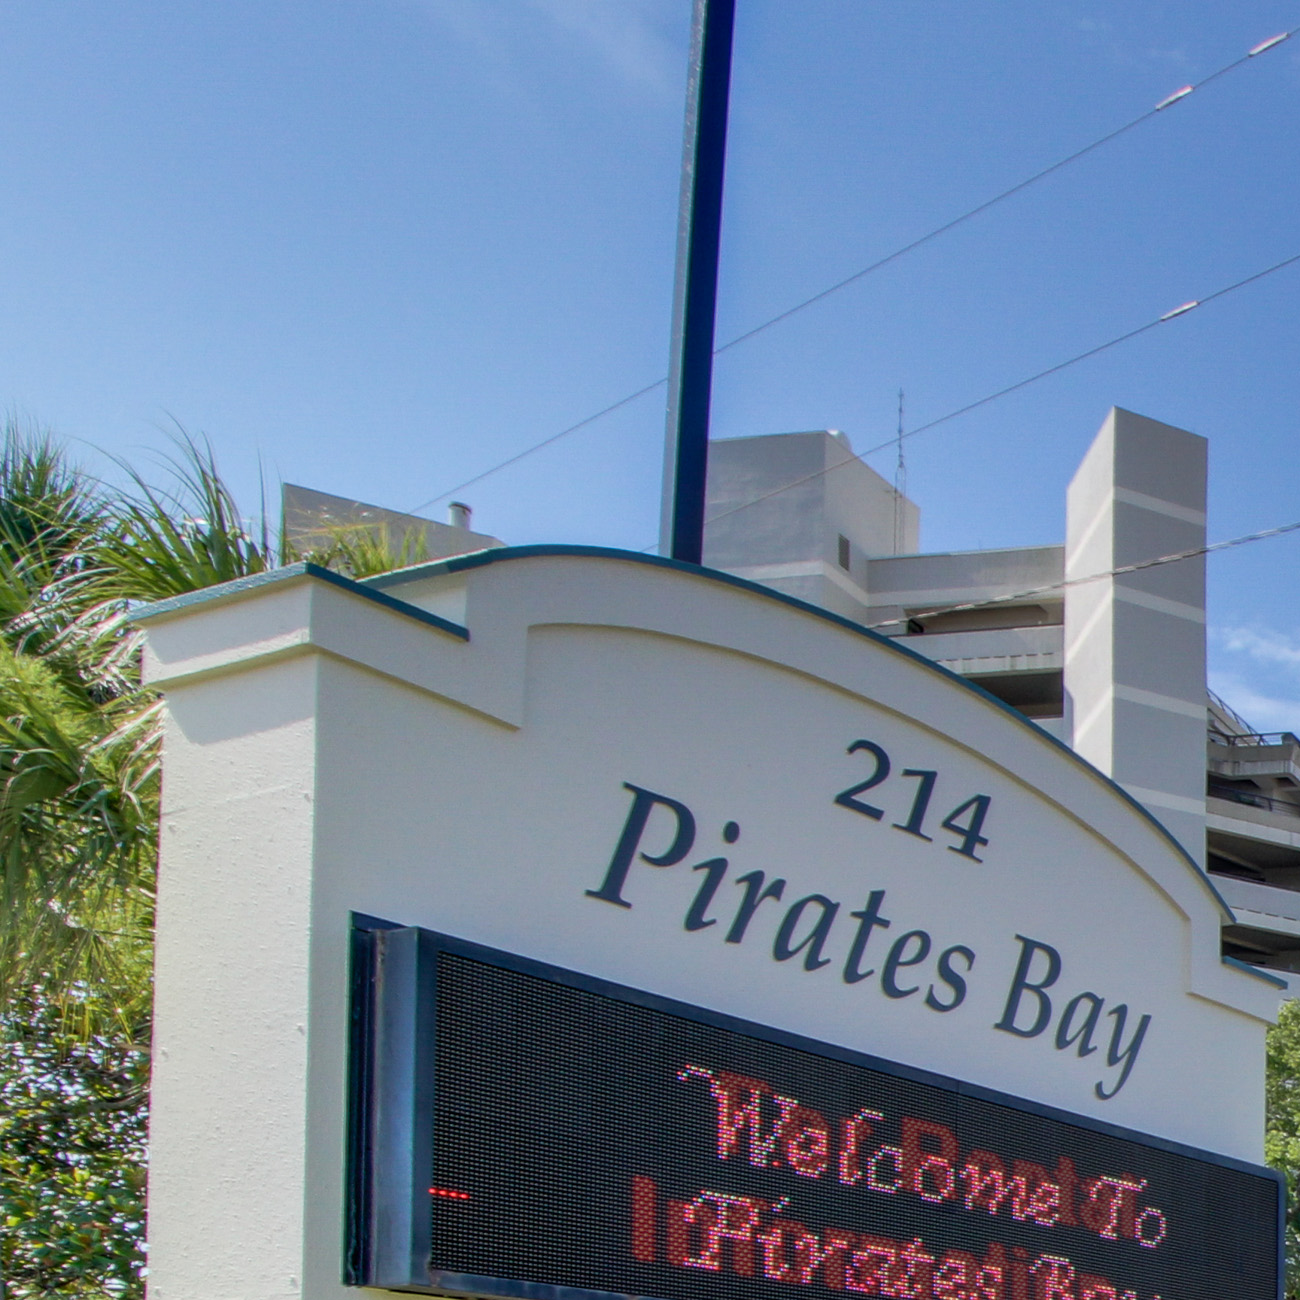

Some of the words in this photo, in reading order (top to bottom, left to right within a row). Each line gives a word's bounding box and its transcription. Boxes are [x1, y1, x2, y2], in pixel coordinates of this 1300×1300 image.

[834, 738, 992, 864] 214
[584, 781, 977, 1014] Pirates
[994, 933, 1153, 1101] Bay
[677, 1062, 1062, 1229] Welcome
[1089, 1173, 1168, 1249] To
